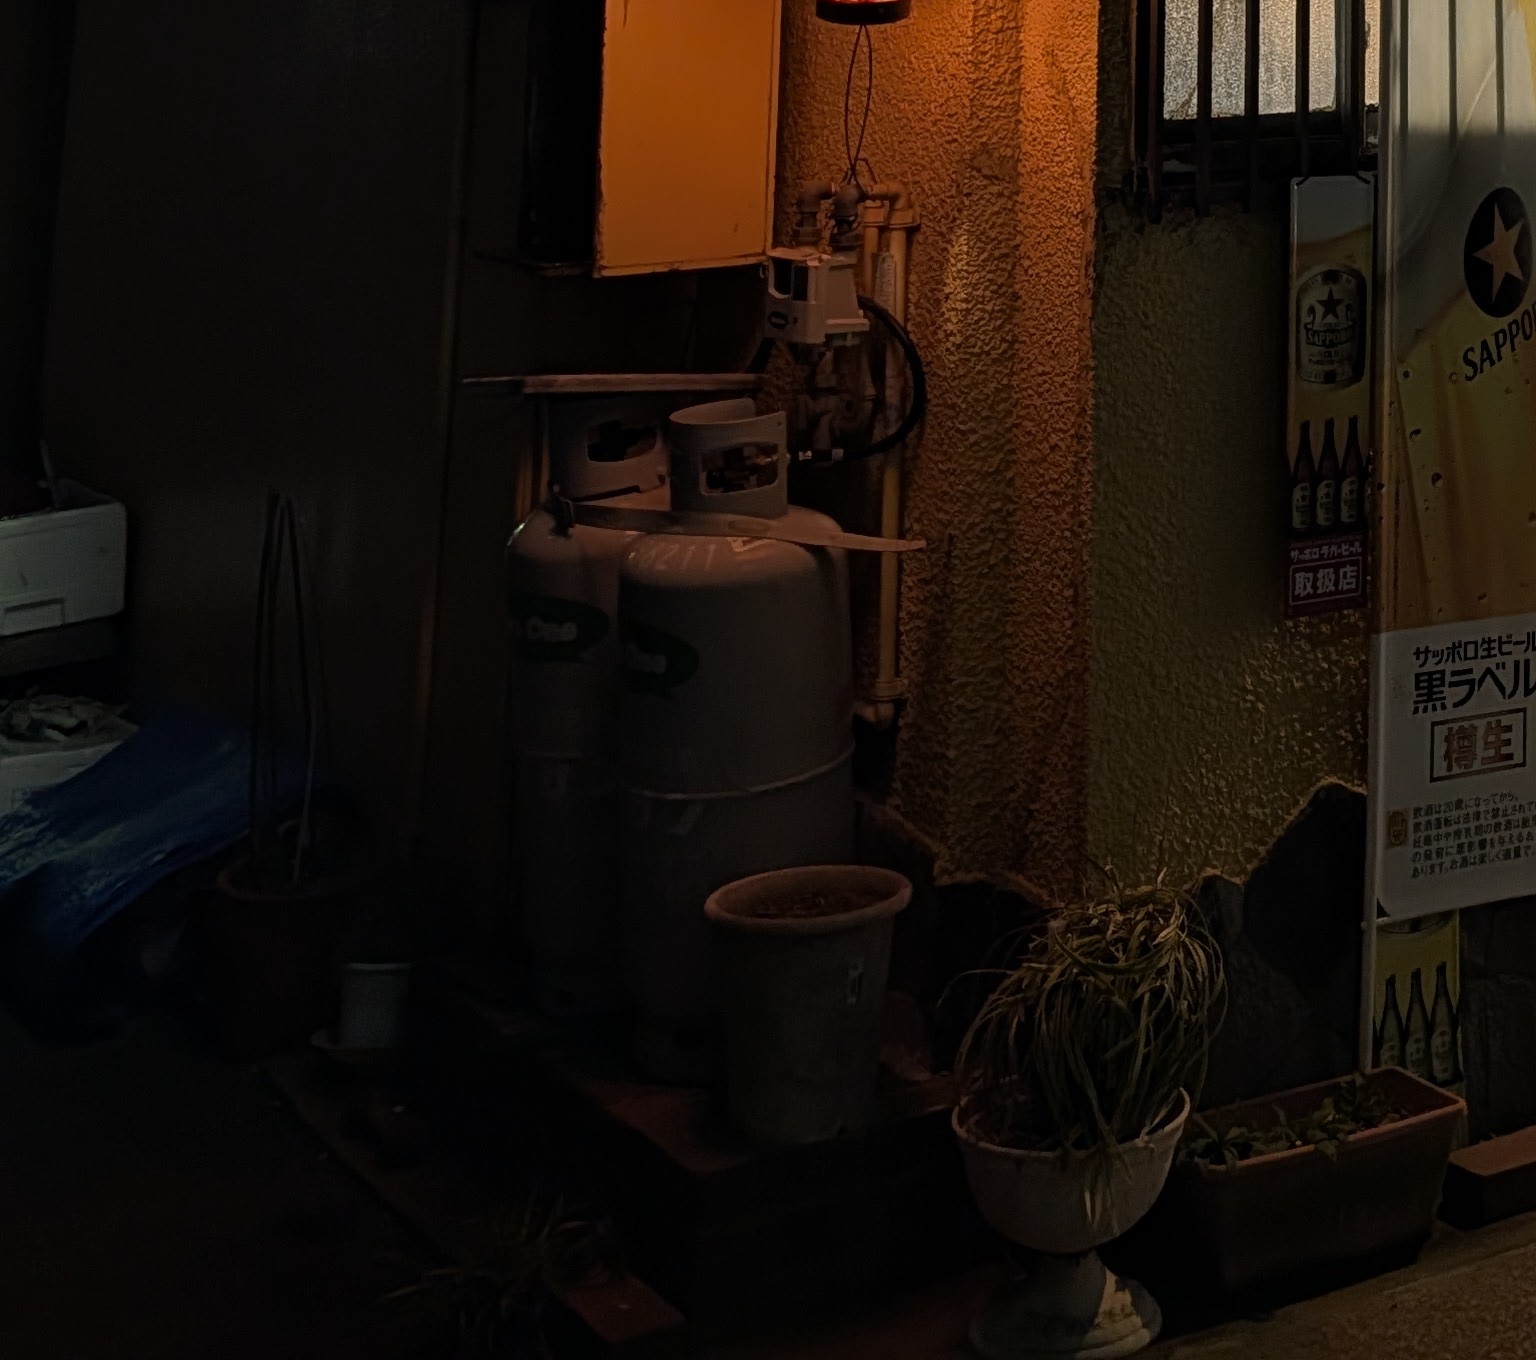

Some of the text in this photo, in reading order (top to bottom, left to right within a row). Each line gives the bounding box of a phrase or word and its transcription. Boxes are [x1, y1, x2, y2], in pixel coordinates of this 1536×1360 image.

[1294, 565, 1358, 598] 取扱店
[1443, 718, 1515, 773] 樽生
